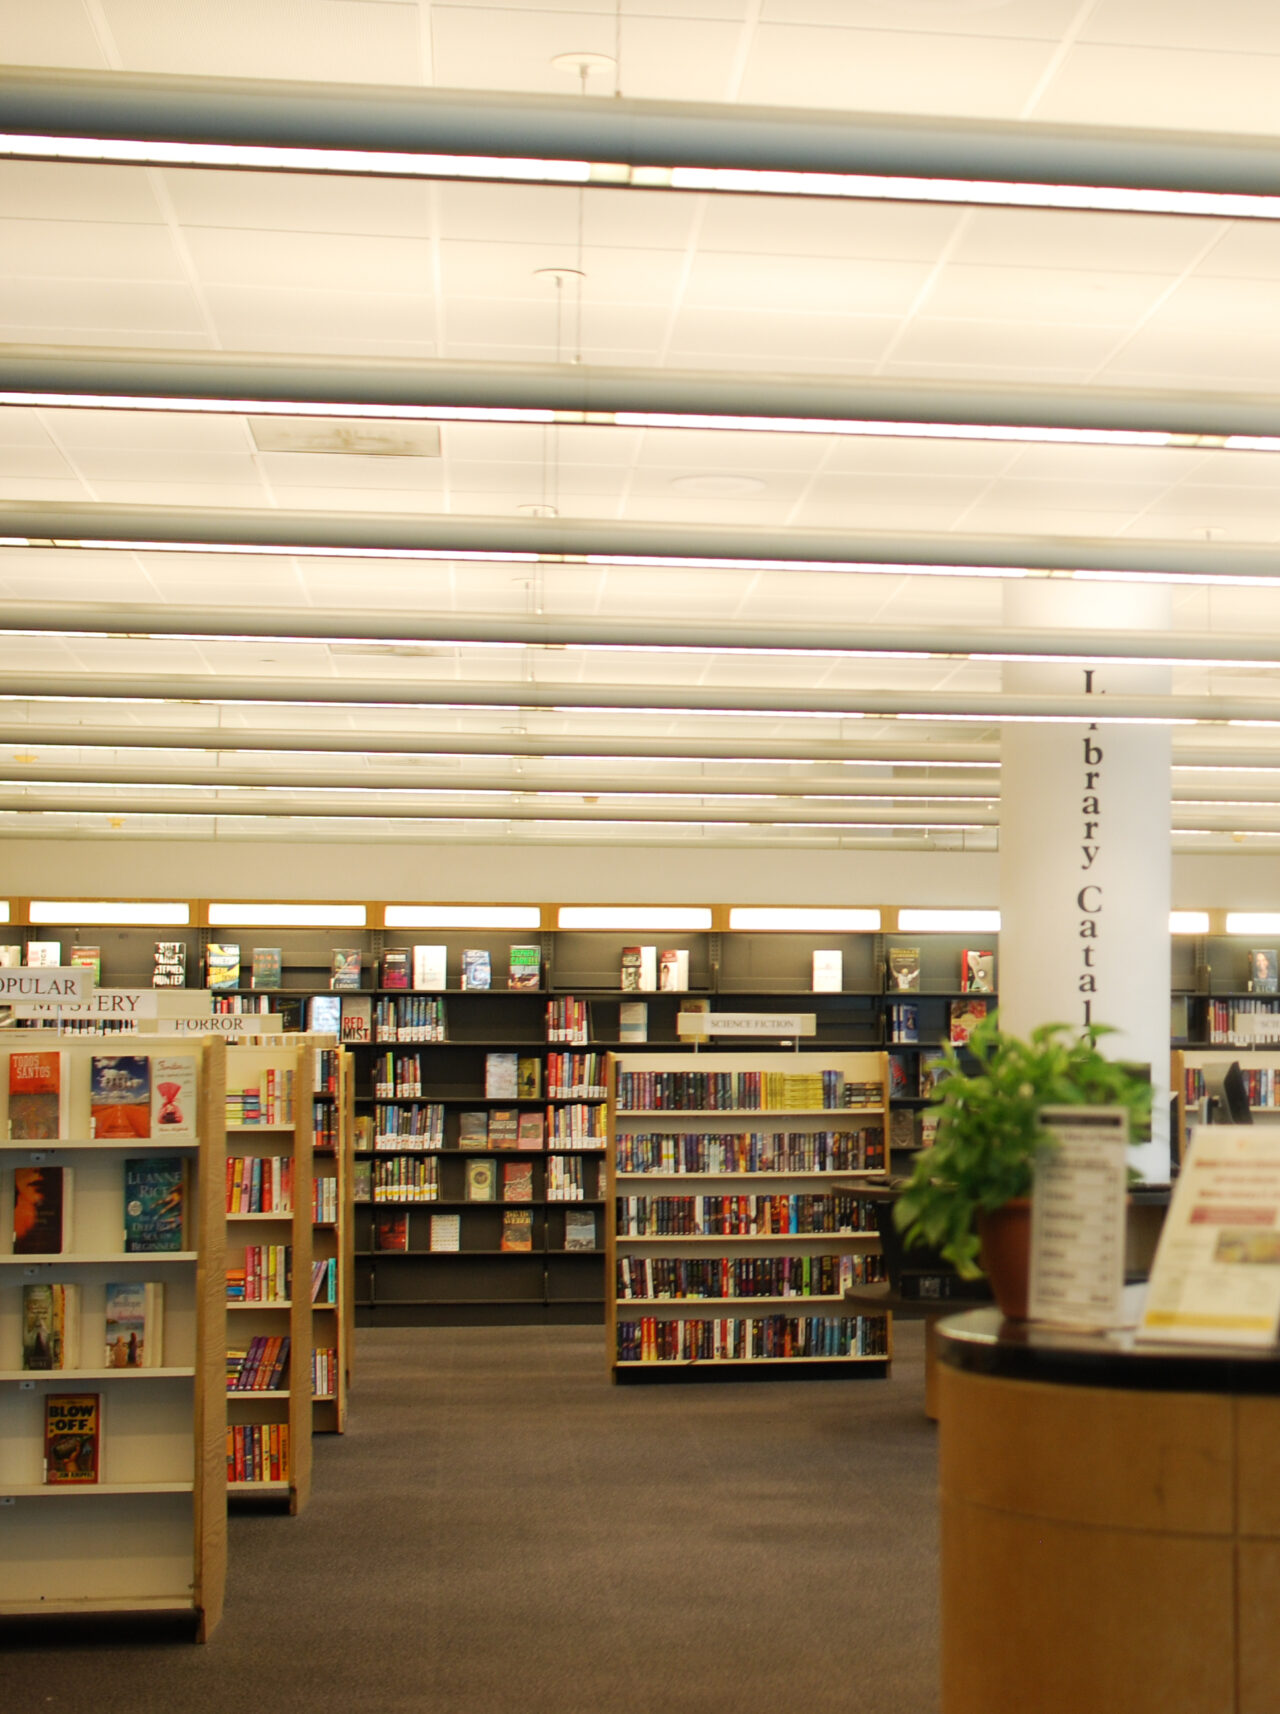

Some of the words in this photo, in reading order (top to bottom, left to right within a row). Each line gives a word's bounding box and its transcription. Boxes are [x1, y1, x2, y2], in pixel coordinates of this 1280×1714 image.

[175, 1017, 244, 1031] HORROR
[343, 1017, 364, 1029] RED
[711, 1019, 751, 1029] SCIENCE
[754, 1019, 794, 1029] FICTION
[343, 1028, 369, 1041] MIST
[17, 1066, 51, 1079] SANTOS
[49, 1406, 94, 1418] BLOW
